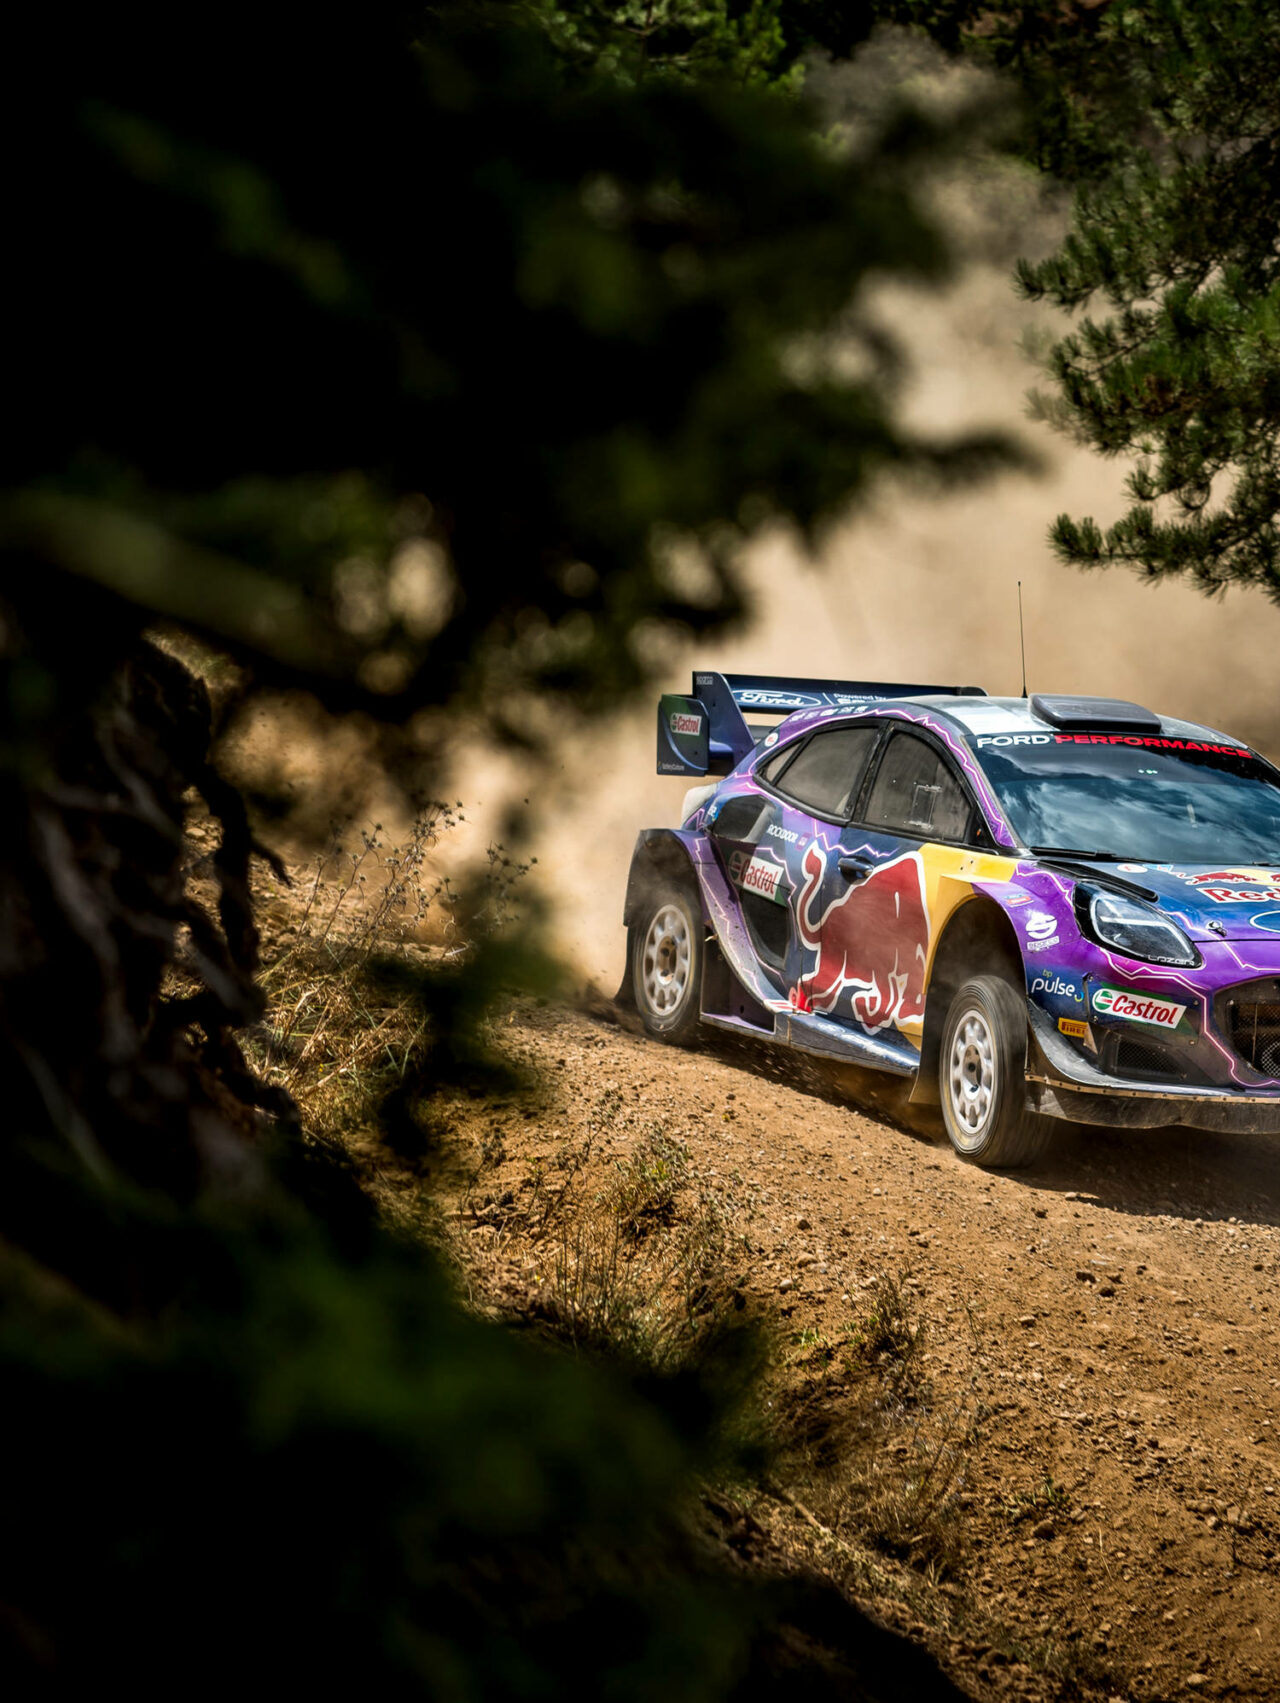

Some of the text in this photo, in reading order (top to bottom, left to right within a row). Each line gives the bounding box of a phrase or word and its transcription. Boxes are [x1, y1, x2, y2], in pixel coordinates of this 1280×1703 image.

[739, 691, 805, 705] Ford
[977, 734, 1253, 759] FORD PERFORMANCE
[740, 860, 779, 895] Castrol
[1031, 976, 1076, 997] pulse
[1112, 995, 1179, 1025] Castrol
